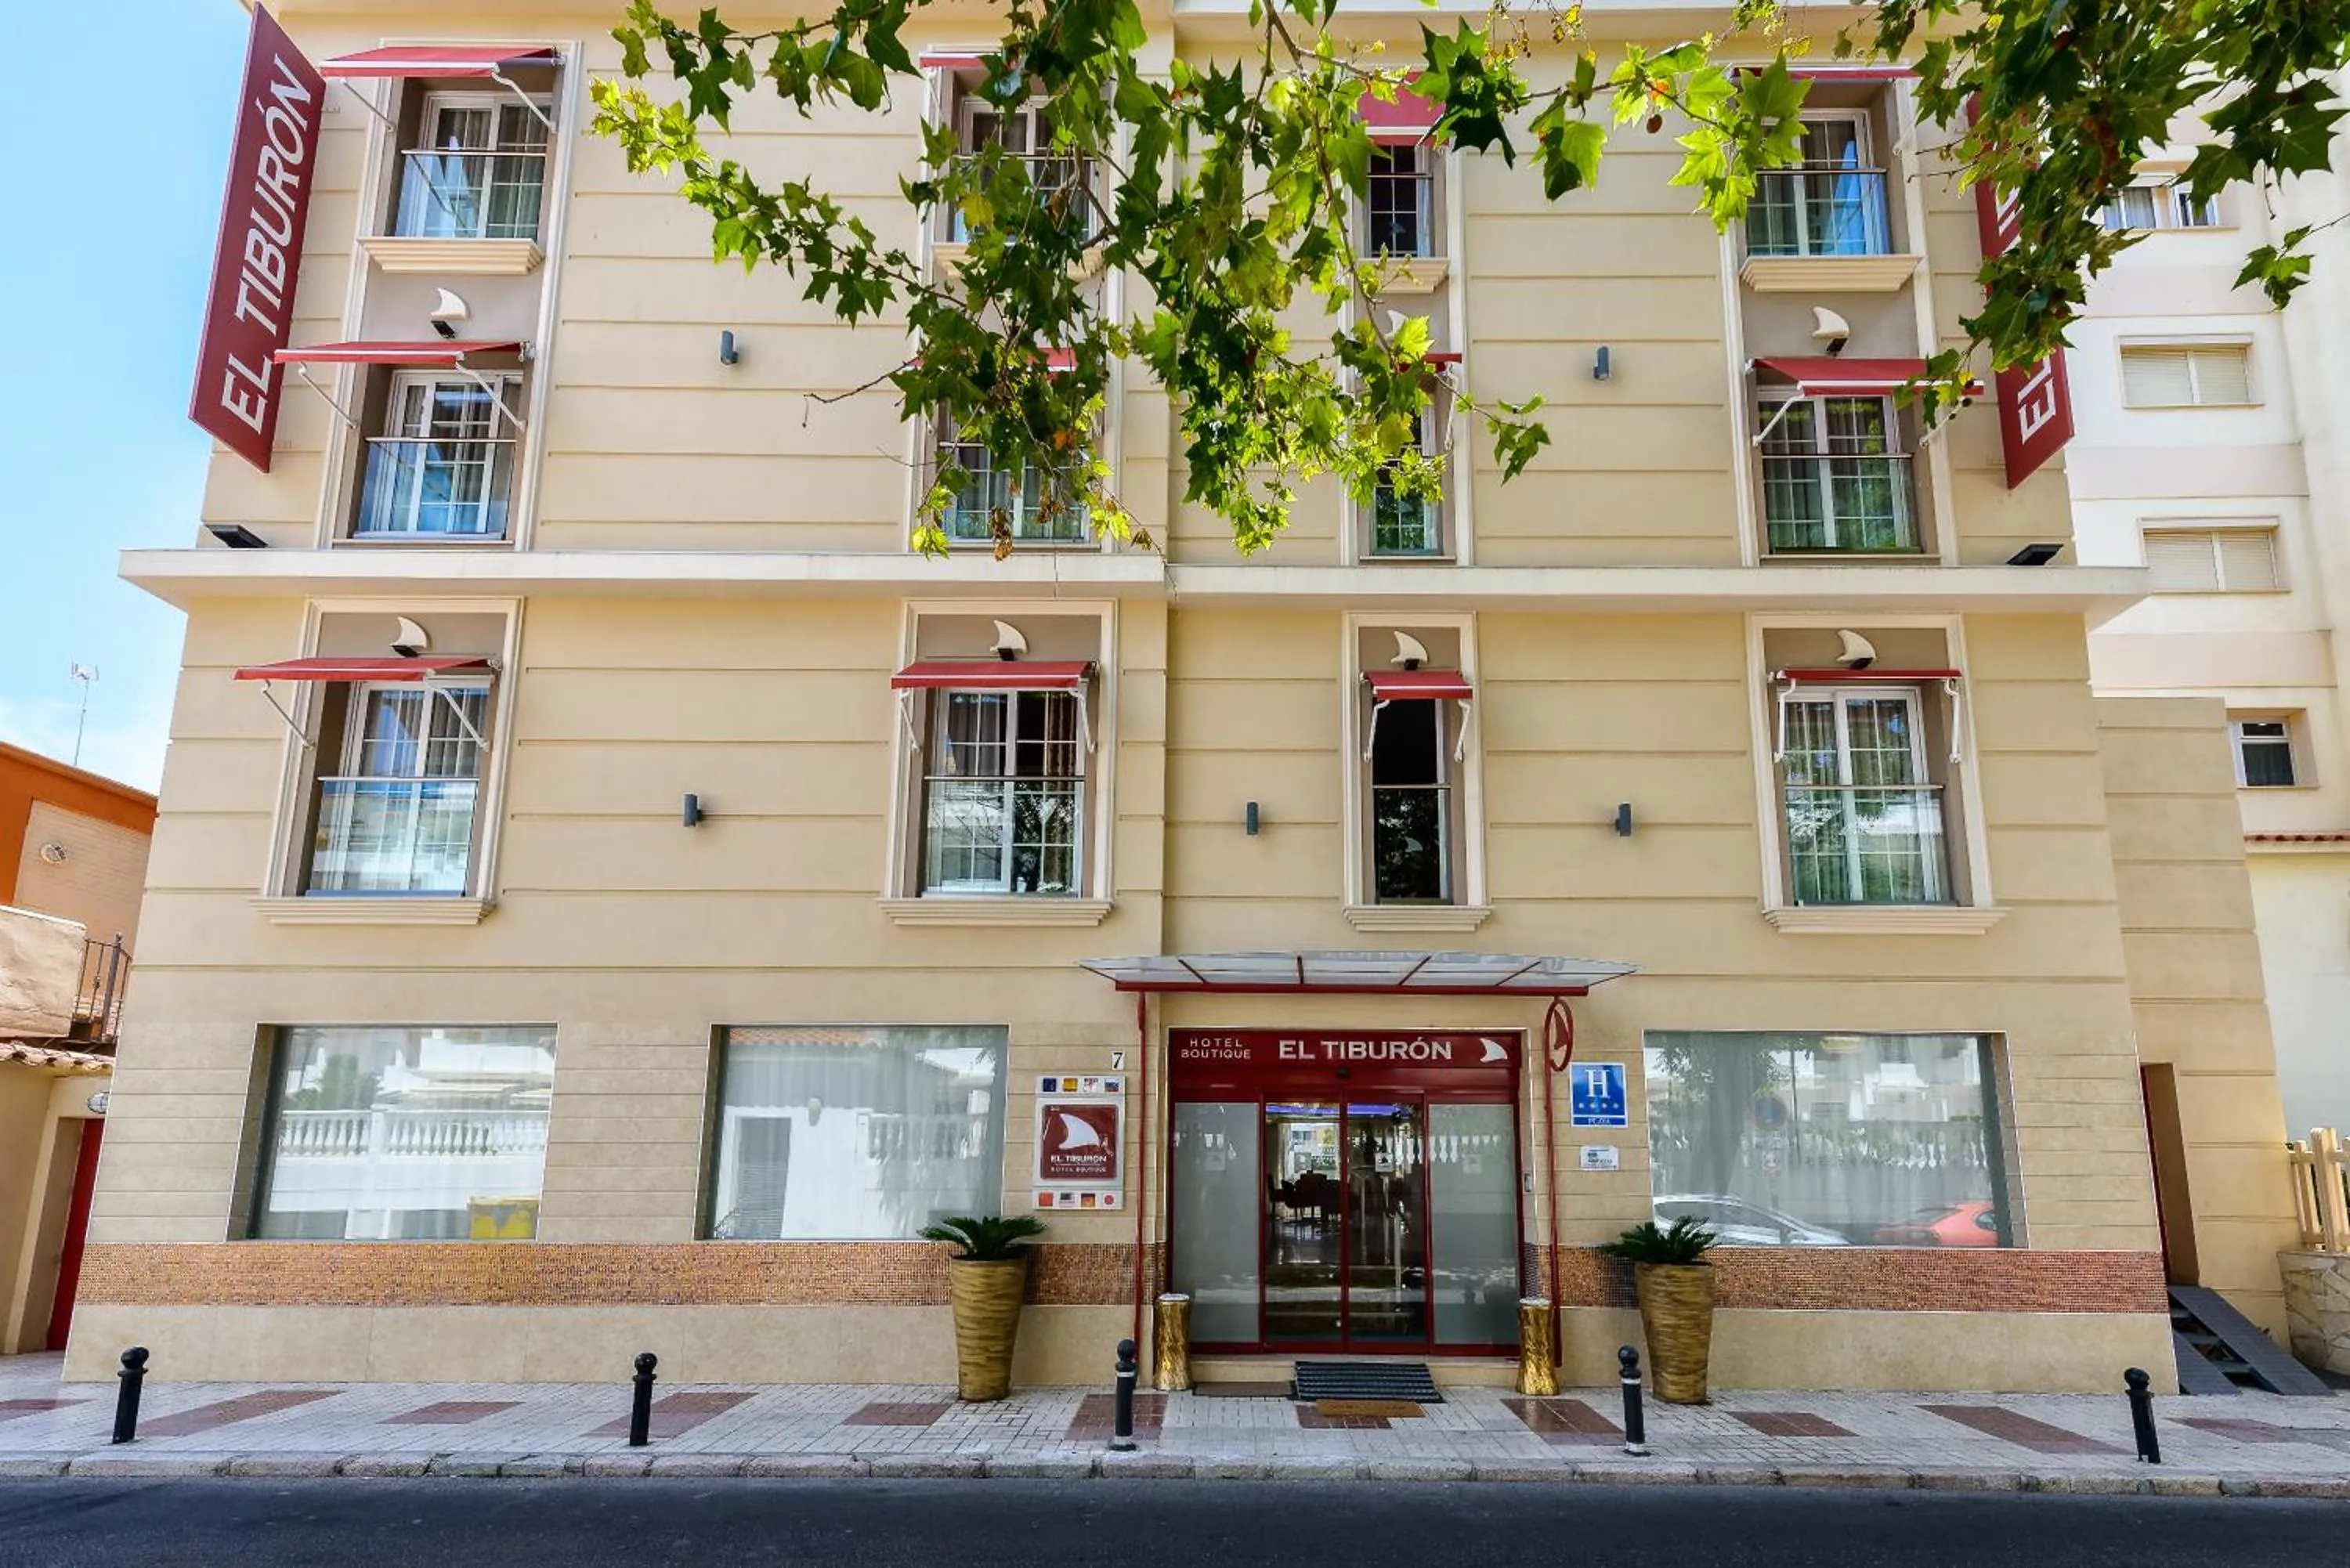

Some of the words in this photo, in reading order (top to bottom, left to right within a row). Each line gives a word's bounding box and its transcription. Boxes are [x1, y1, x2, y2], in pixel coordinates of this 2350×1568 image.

[234, 54, 312, 337] TIBURÓN
[221, 353, 272, 435] EL
[1180, 1049, 1251, 1059] BOUTIQUE
[1190, 1038, 1243, 1047] HOTEL
[1279, 1040, 1316, 1059] EL
[1321, 1036, 1452, 1059] TIBURÓN
[1113, 1052, 1123, 1068] 7
[1585, 1069, 1611, 1098] H
